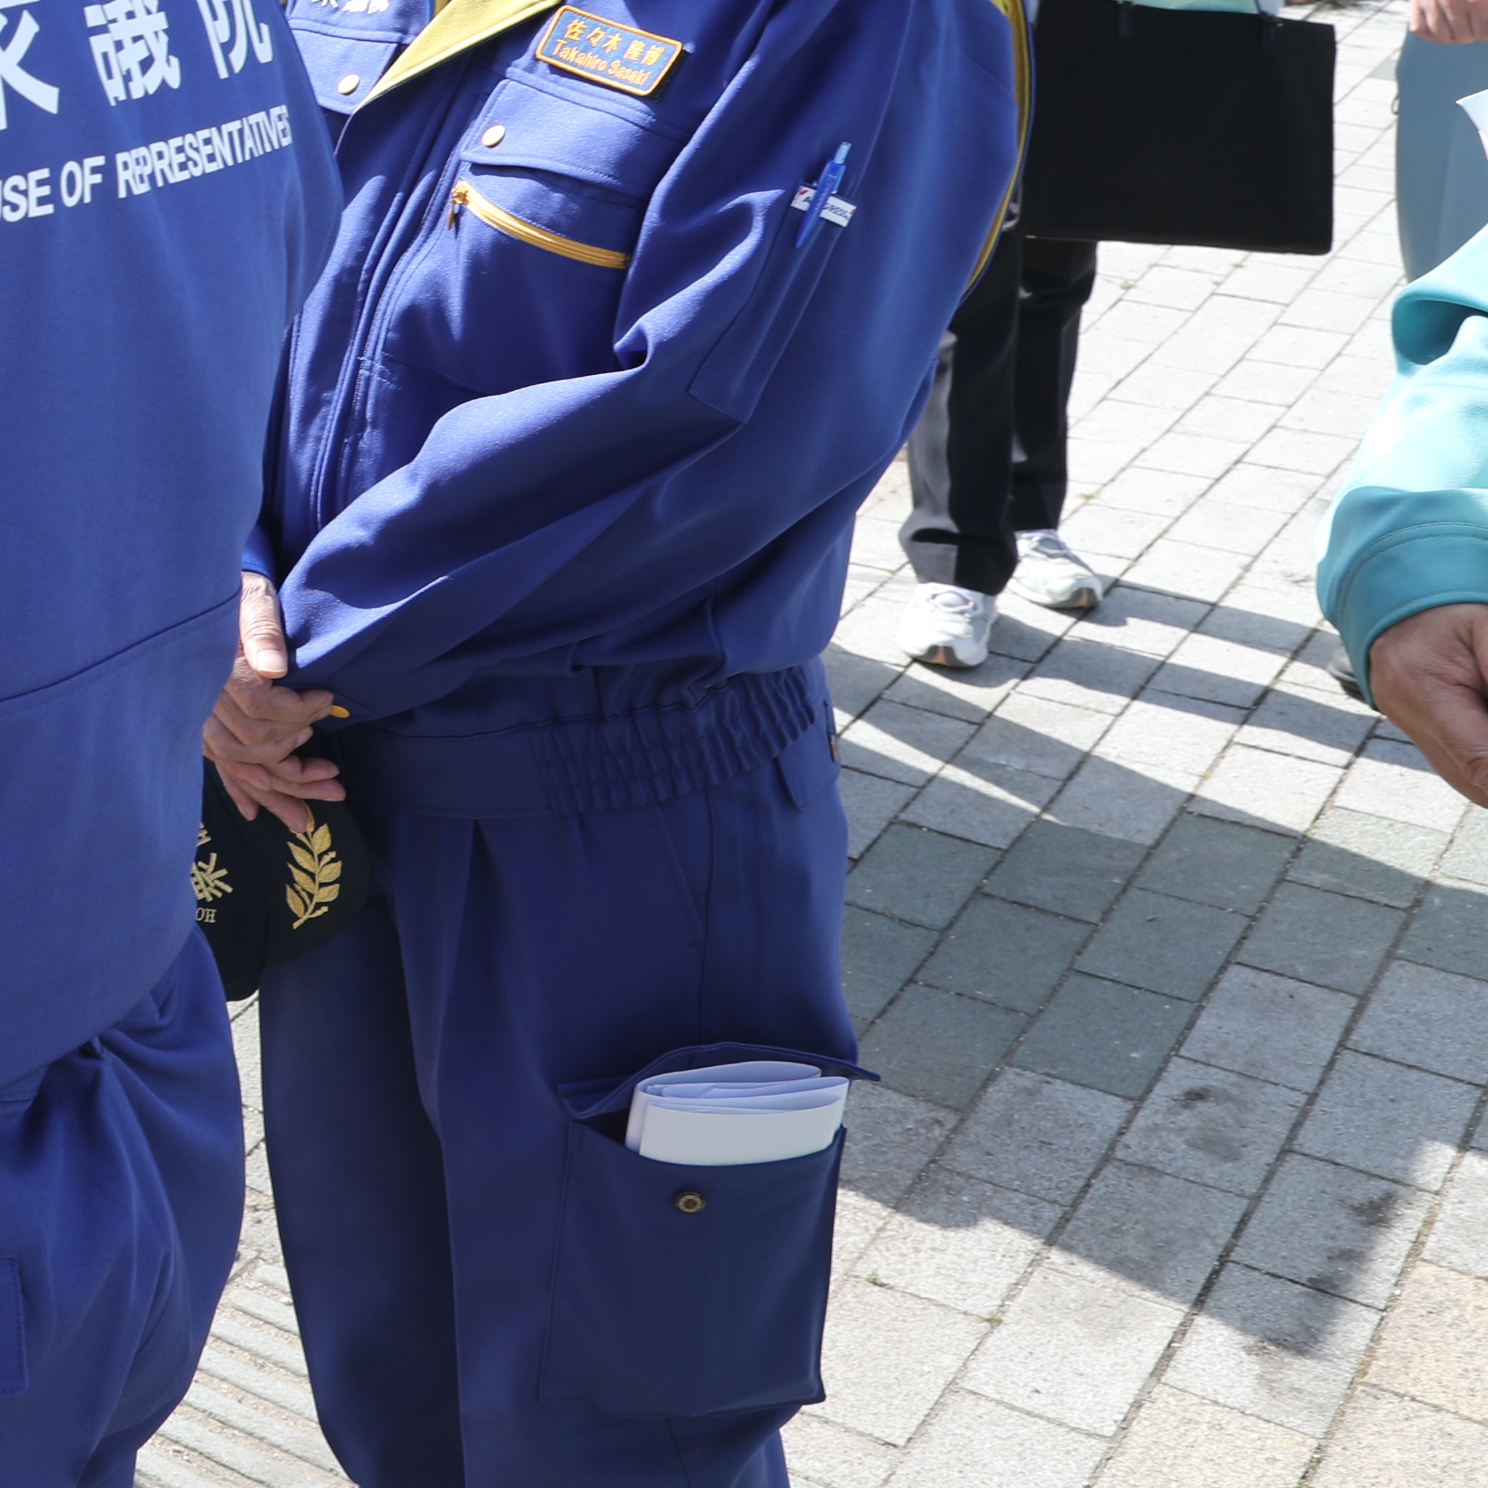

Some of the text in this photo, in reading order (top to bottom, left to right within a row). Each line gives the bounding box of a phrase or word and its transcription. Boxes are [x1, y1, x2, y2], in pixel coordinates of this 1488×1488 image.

[563, 19, 623, 53] 佐々木
[552, 39, 652, 86] Takahiro Sasaki
[60, 155, 106, 207] OF
[115, 104, 293, 198] REPRESENTATIVES
